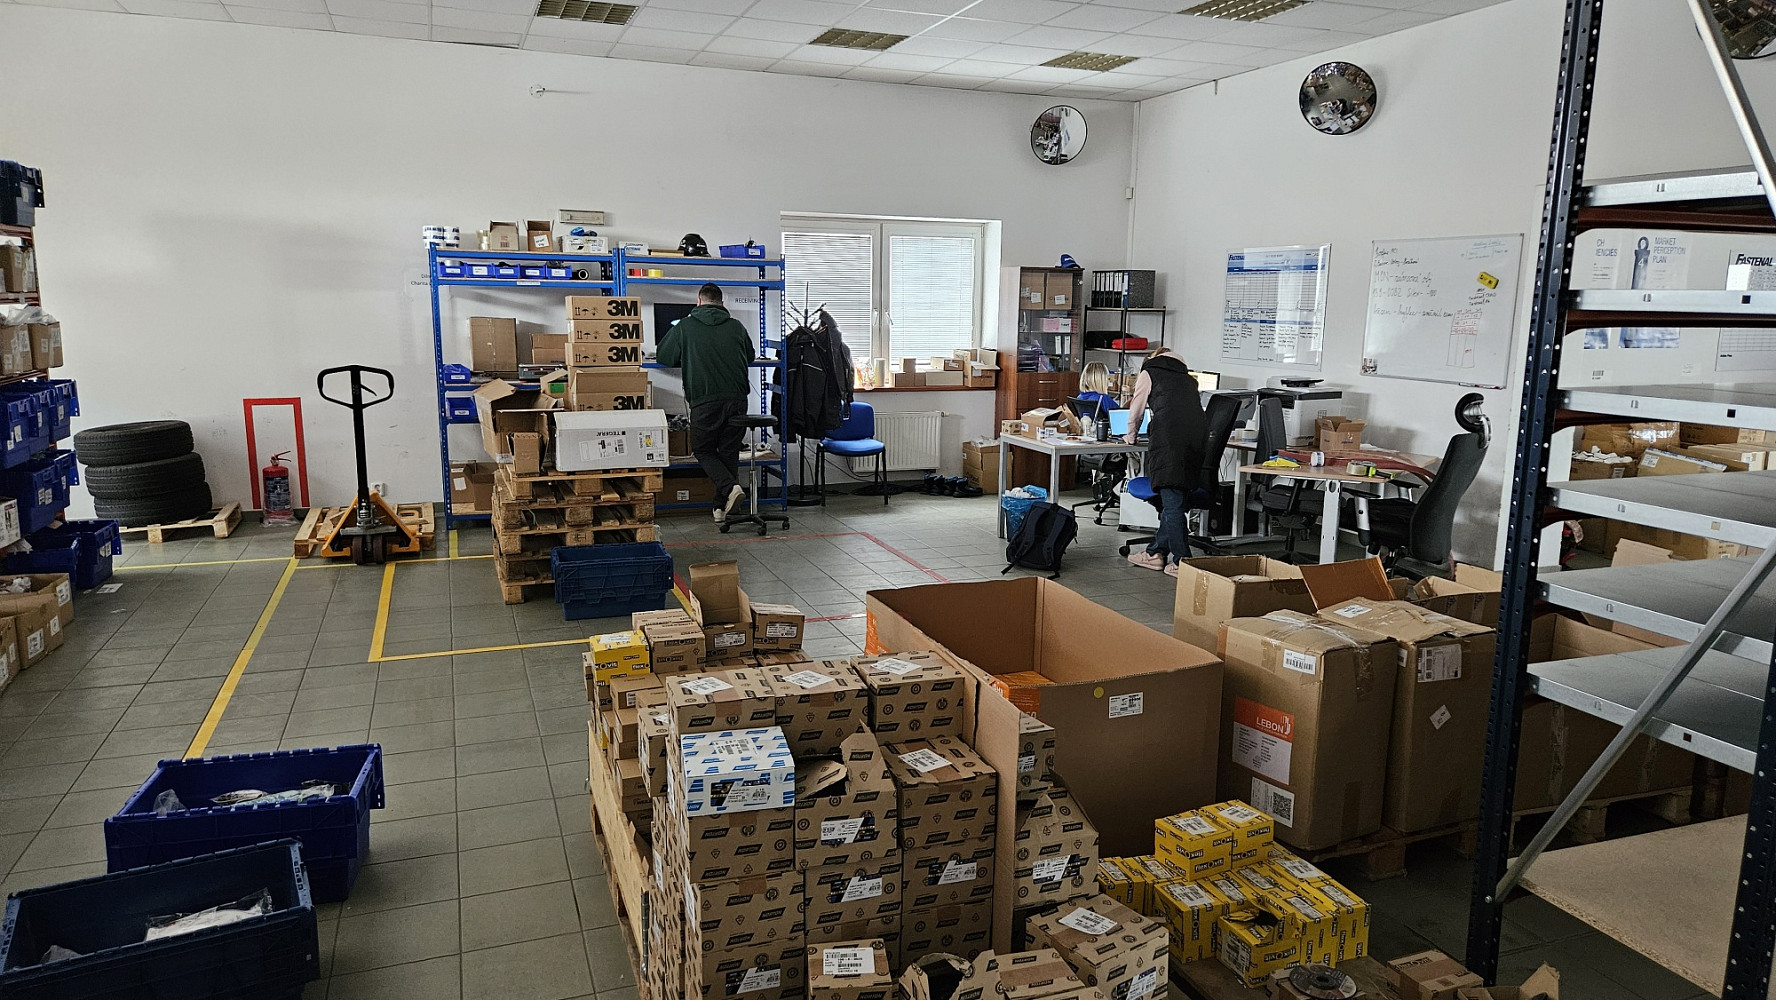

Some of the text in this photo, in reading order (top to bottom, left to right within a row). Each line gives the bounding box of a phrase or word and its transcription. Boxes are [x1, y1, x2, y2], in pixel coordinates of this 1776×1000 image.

[1655, 237, 1676, 245] MARKET
[1653, 246, 1686, 255] PERCEPTION
[1736, 254, 1772, 266] FASTENAL
[608, 300, 638, 316] 3M
[609, 323, 640, 339] 3M
[608, 346, 638, 362] 3M
[613, 396, 644, 410] 3M
[1256, 717, 1284, 734] LEBON
[1040, 845, 1061, 854] NORTON
[759, 908, 785, 919] NORTON
